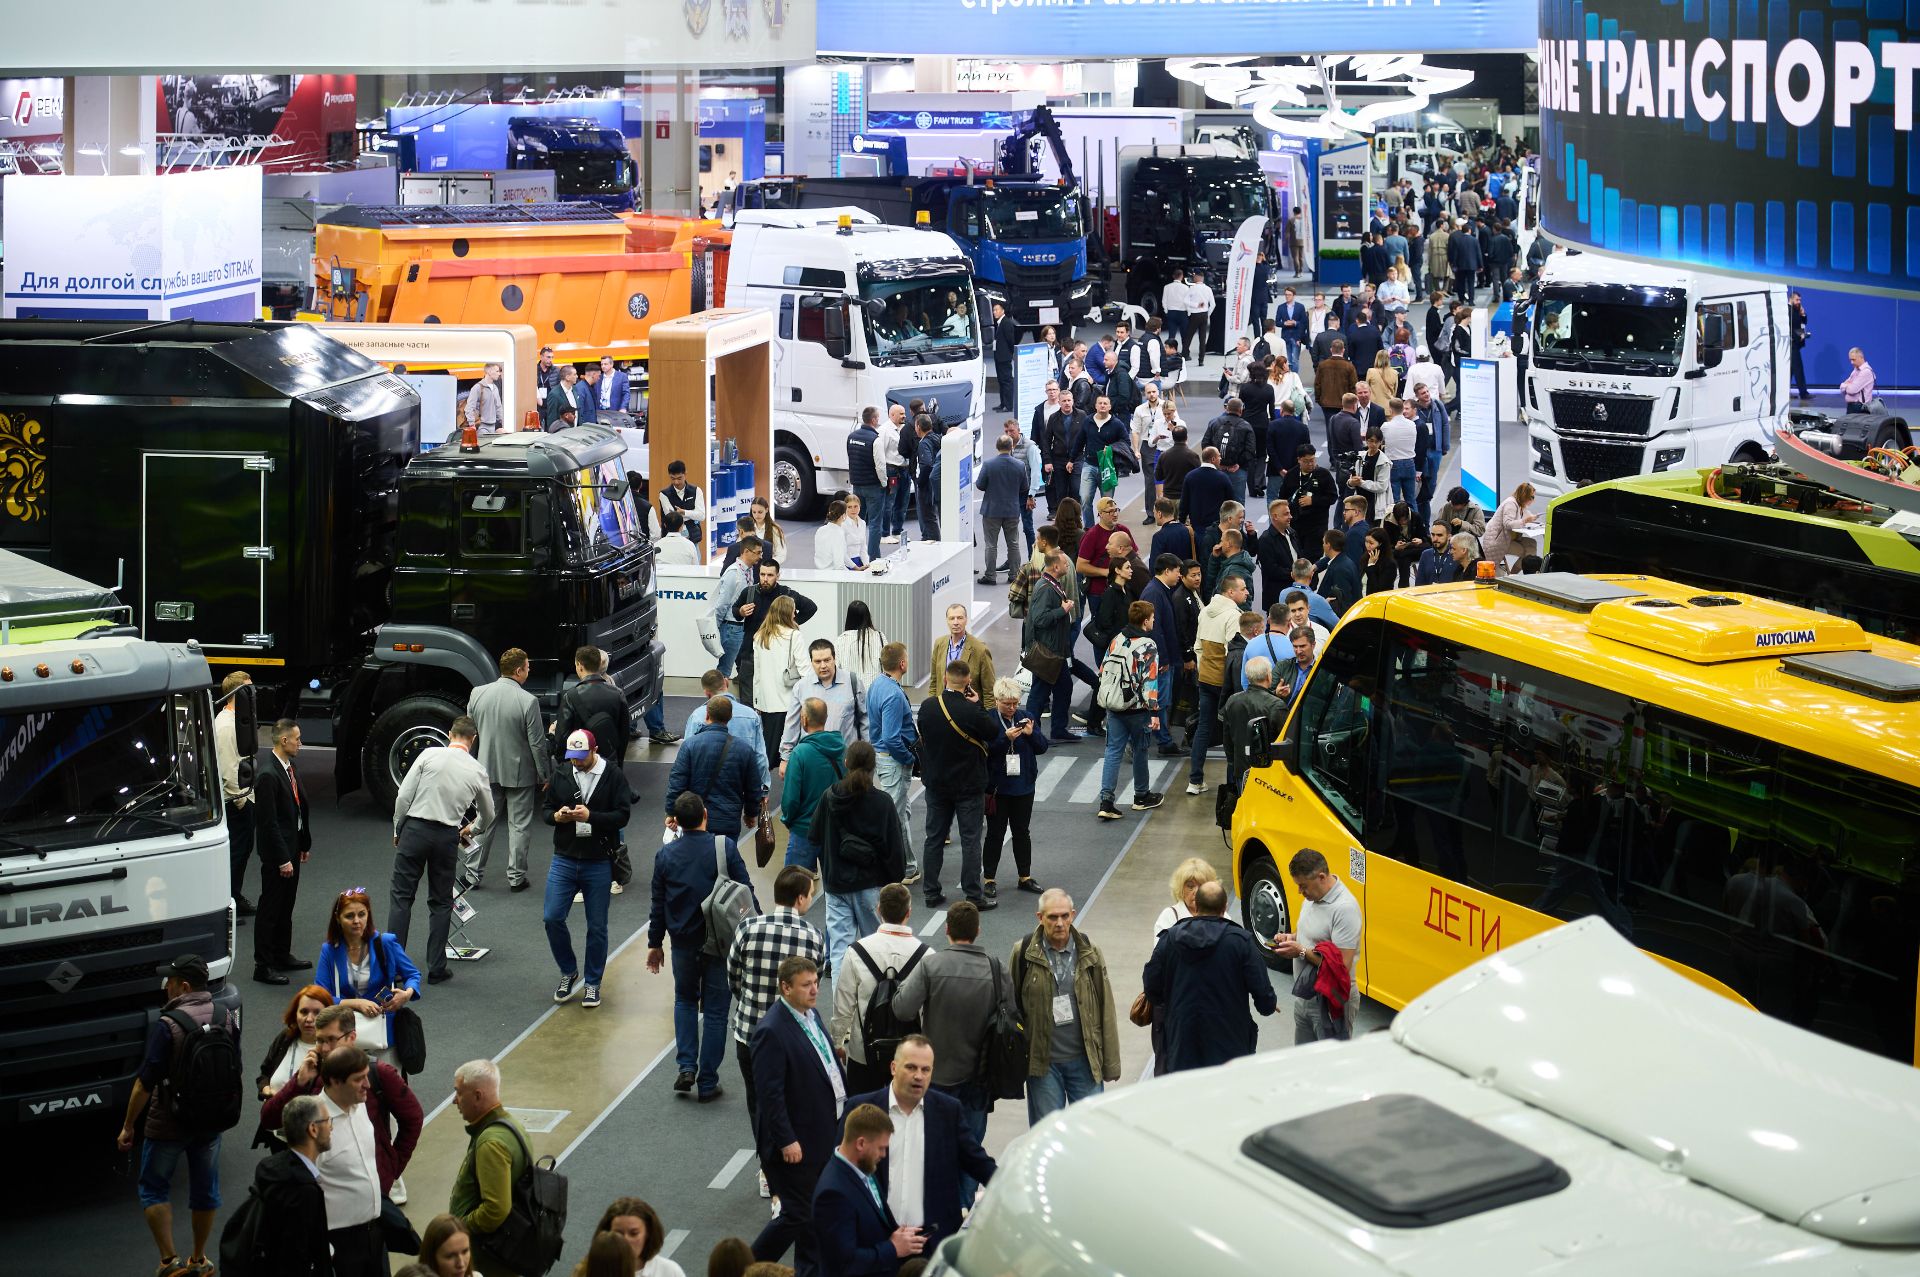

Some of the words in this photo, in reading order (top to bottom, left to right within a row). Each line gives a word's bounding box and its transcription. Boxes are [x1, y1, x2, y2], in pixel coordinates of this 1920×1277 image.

[36, 97, 63, 120] РЕМ
[933, 116, 950, 125] FAW
[951, 116, 974, 126] TRUCKS
[1022, 254, 1057, 263] IVECO
[20, 271, 60, 292] Для
[64, 272, 136, 293] долгой
[140, 270, 189, 294] службы
[191, 268, 223, 286] вашего
[223, 258, 255, 281] SITRAK
[366, 340, 405, 349] запасные
[406, 341, 430, 349] части
[912, 368, 953, 382] SITRAK
[1568, 378, 1633, 391] SITRAK
[1756, 629, 1816, 647] AUTOCLIMA
[0, 894, 130, 930] URAL
[1424, 886, 1500, 953] ДЕТИ
[28, 1093, 103, 1115] УРАЛ
